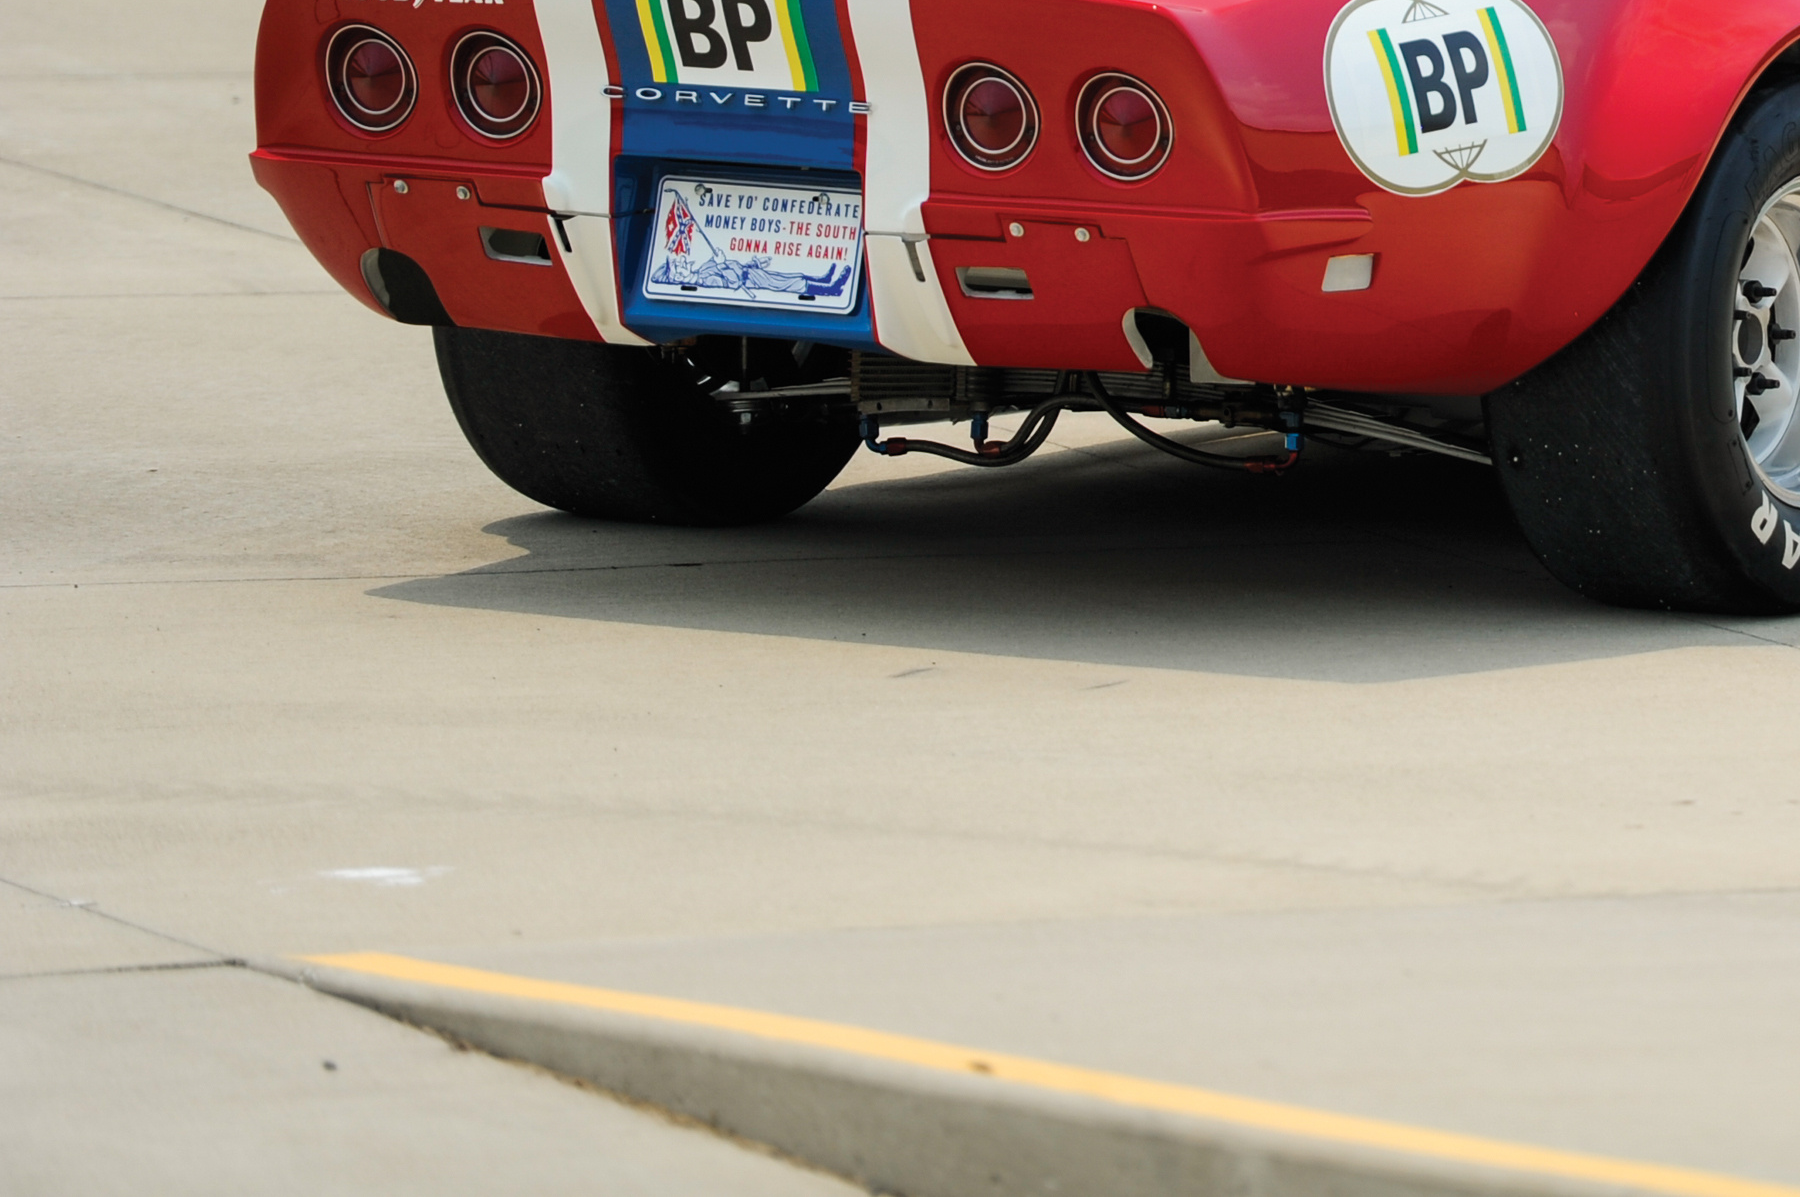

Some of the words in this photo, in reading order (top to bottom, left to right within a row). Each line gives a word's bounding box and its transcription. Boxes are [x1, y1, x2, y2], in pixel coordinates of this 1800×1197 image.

[1398, 30, 1490, 134] BP
[600, 85, 873, 114] CORVETTE
[699, 192, 732, 208] SAVE
[763, 196, 860, 219] CONFEDERATE
[704, 214, 747, 231] MONEY
[816, 223, 857, 241] SOUTH
[730, 237, 768, 254] GONNA
[775, 240, 801, 257] RISE
[807, 243, 848, 261] AGAIN!
